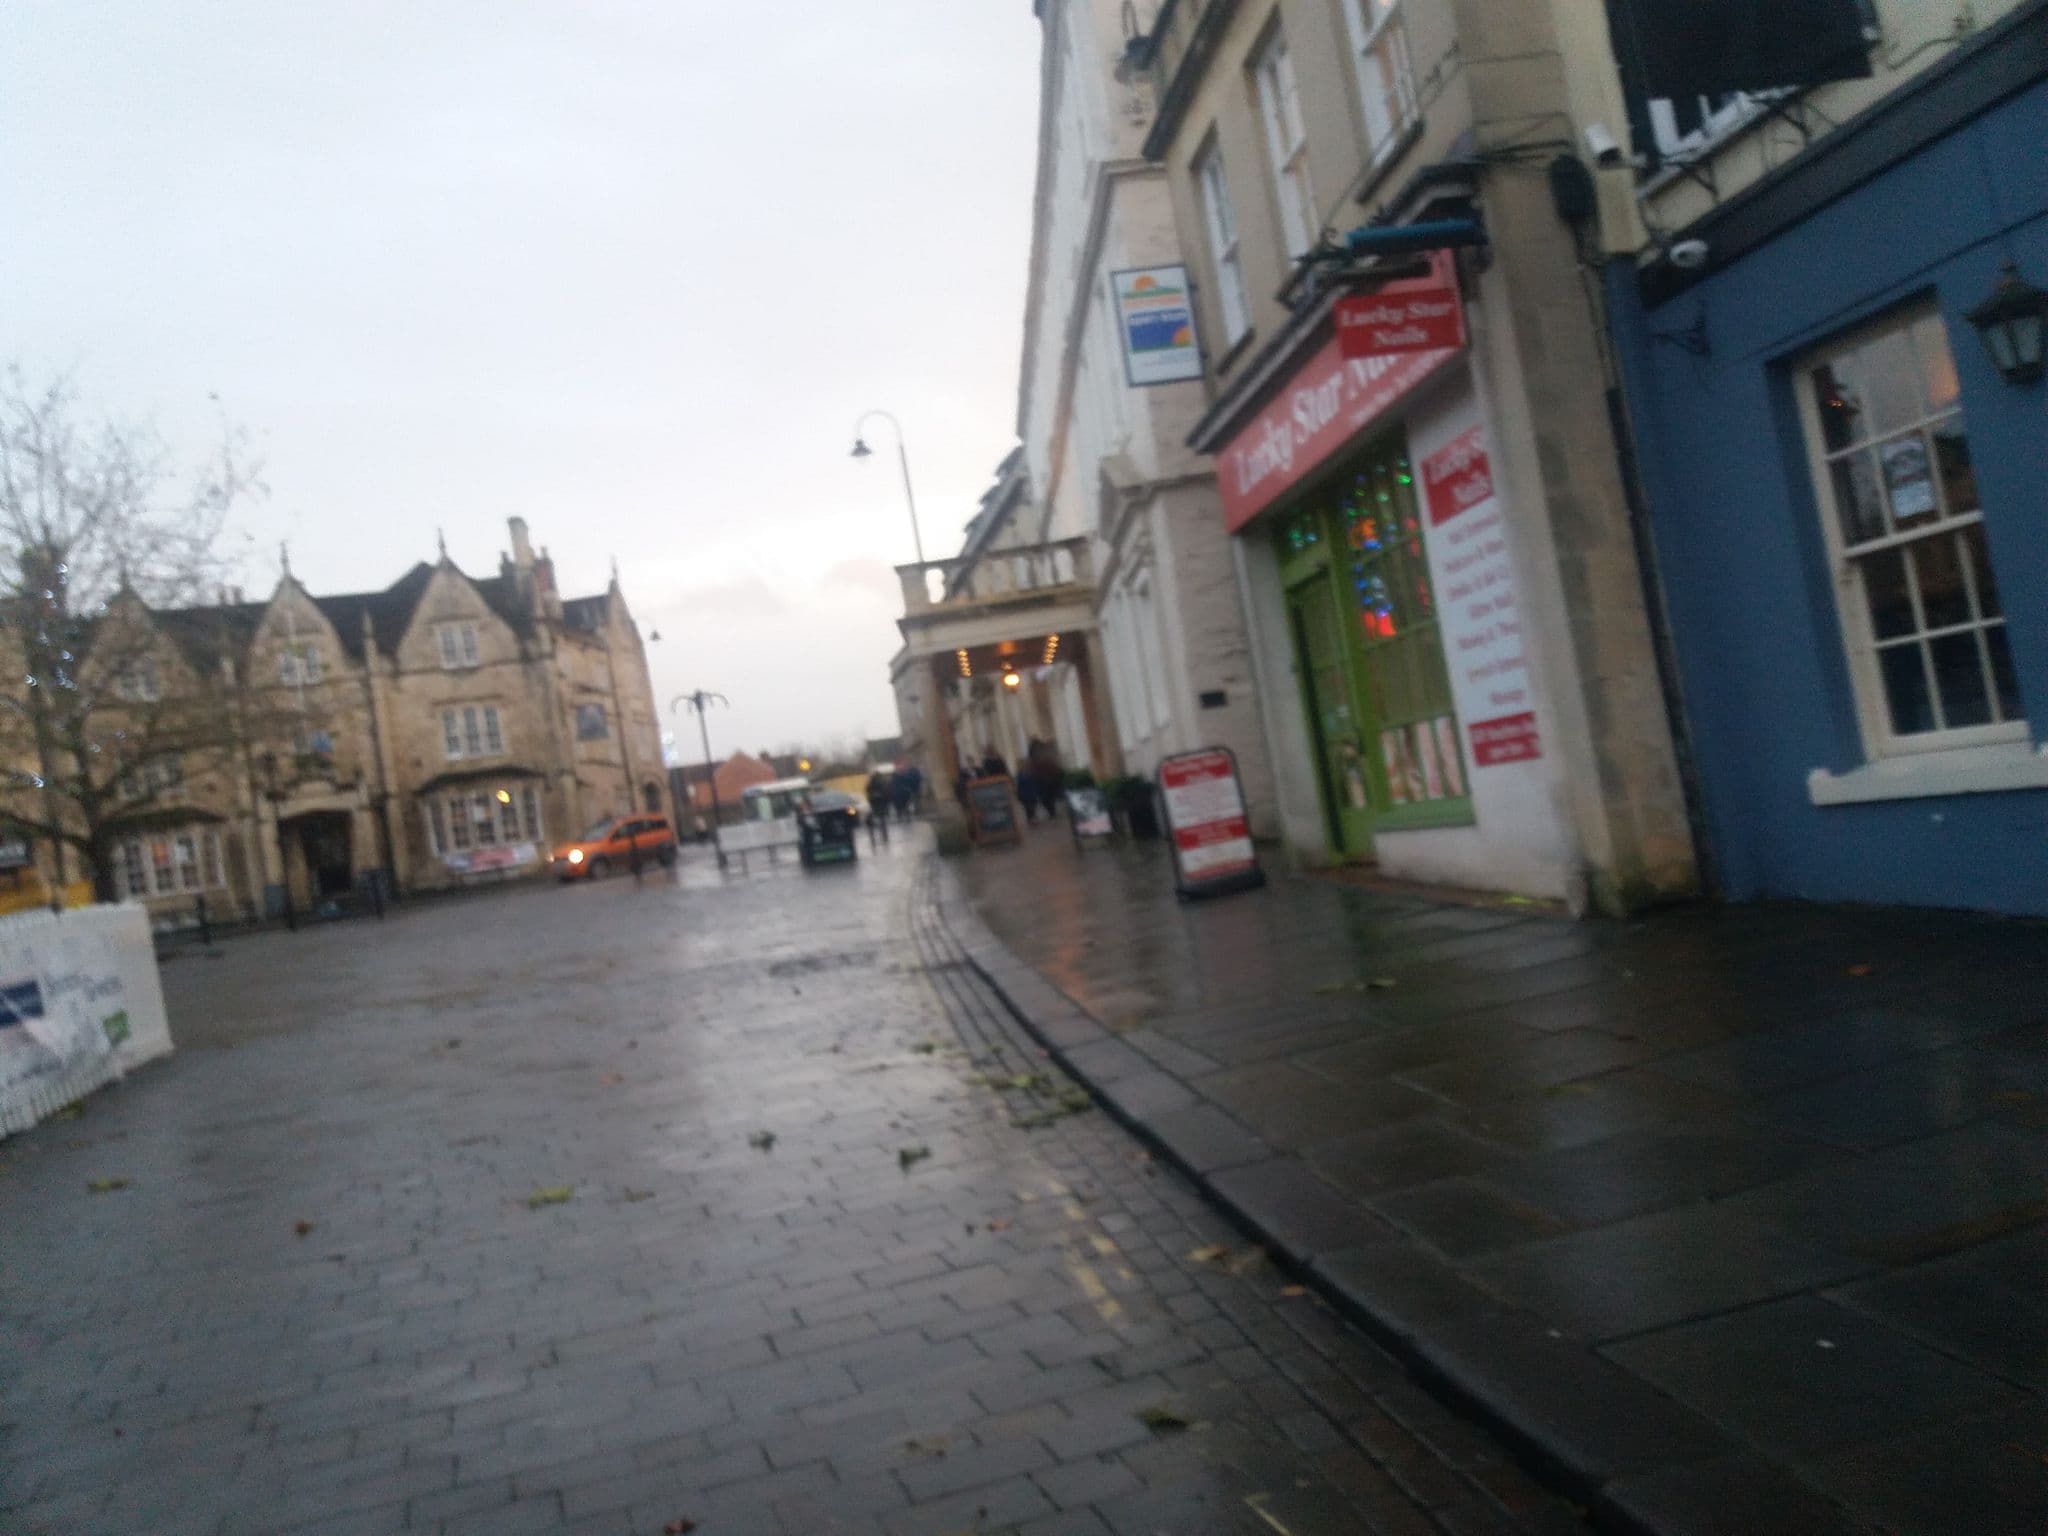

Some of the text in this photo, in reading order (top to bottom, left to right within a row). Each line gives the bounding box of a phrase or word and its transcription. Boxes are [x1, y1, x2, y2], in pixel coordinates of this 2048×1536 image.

[1341, 303, 1405, 328] Lucky
[1372, 329, 1429, 348] Nails
[1235, 416, 1294, 495] Lucky
[1292, 371, 1345, 445] Star
